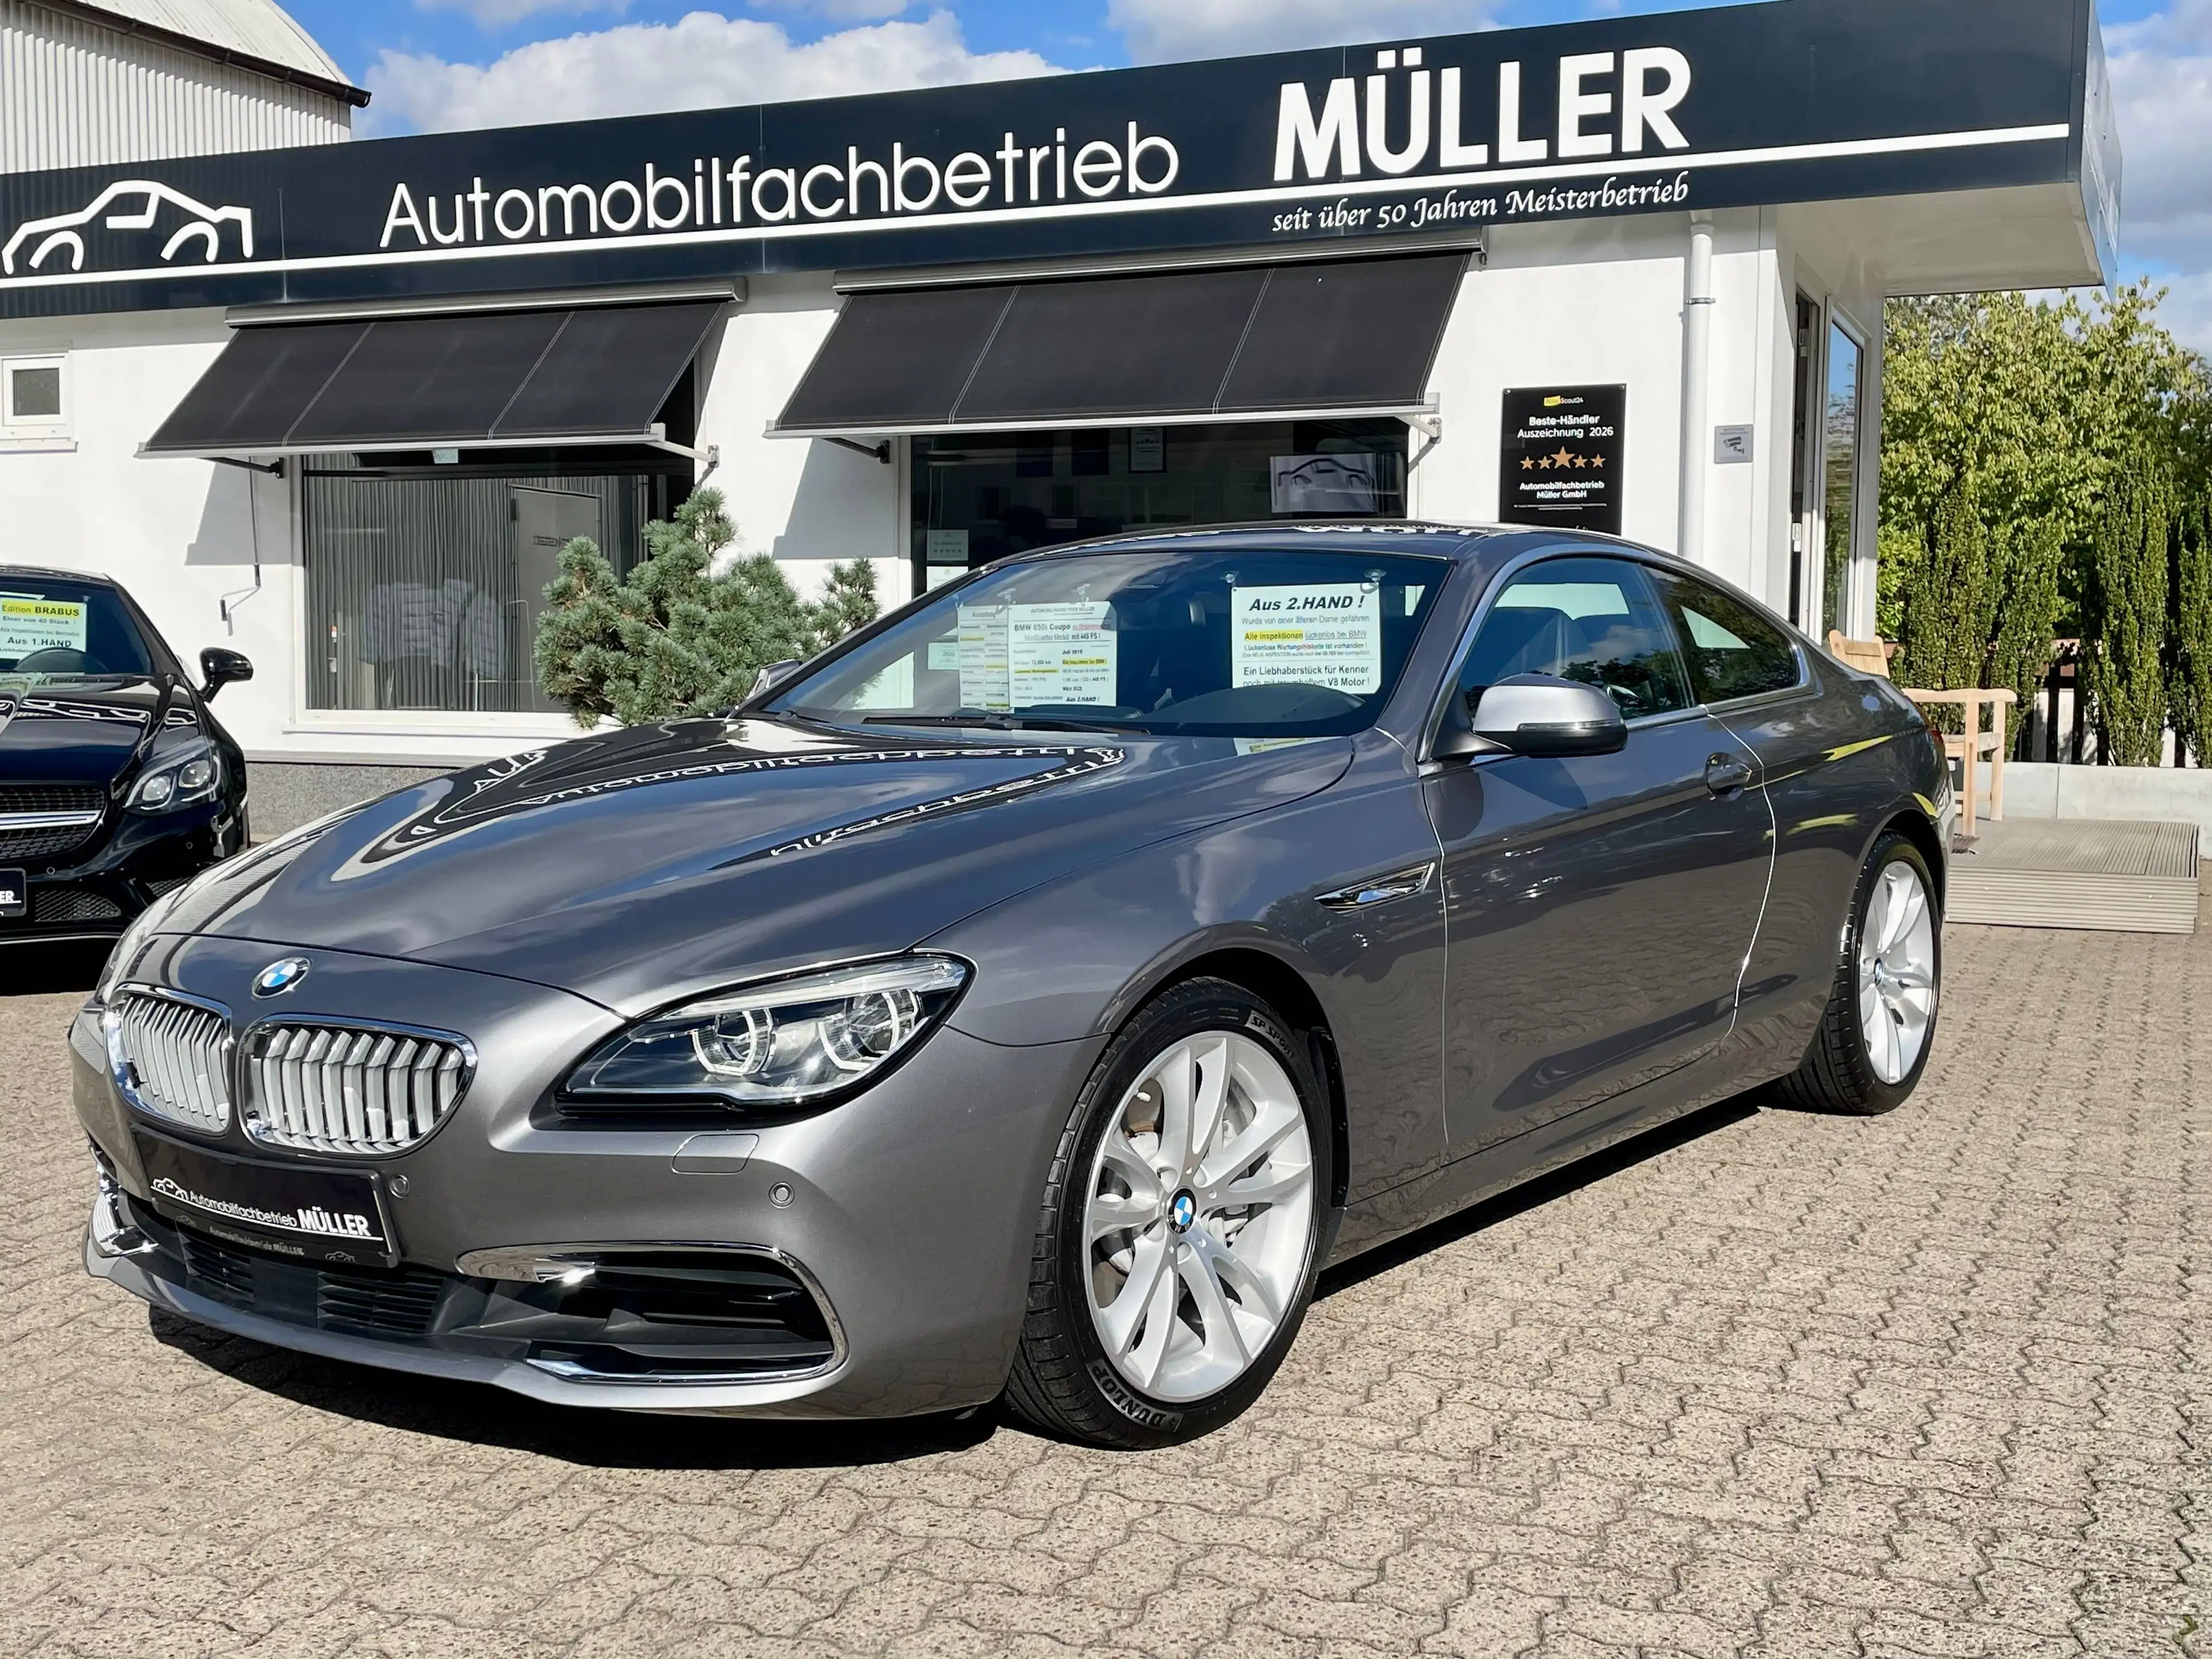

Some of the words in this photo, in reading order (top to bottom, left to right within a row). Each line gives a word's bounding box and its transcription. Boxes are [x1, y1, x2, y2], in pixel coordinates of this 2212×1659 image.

[1273, 46, 1692, 182] MÜLLER
[378, 120, 1179, 248] Automobilfachbetrieb
[1272, 210, 1313, 232] seit
[1318, 198, 1372, 227] über
[1376, 203, 1407, 229] 50
[1410, 189, 1497, 228] Jahren
[1505, 171, 1690, 215] Meisterbetrieb
[1528, 415, 1600, 426] Beste-Händler
[1517, 428, 1584, 439] Auszeichnung
[1589, 426, 1614, 437] 2026
[1519, 480, 1605, 491] Automobilfachbetrieb
[1536, 490, 1560, 499] Müller
[1562, 490, 1587, 498] GmbH
[1249, 598, 1282, 611] Aus
[1286, 596, 1353, 611] 2.HAND
[1358, 595, 1365, 608] !
[2, 605, 32, 613] Edition
[35, 606, 79, 616] BRABUS
[1241, 617, 1262, 625] Wurde
[1319, 615, 1339, 623] Dame
[1340, 615, 1370, 624] gefahren
[1014, 624, 1031, 632] BMW
[1259, 631, 1303, 642] Inspektionen
[1349, 630, 1367, 638] BMW
[7, 637, 27, 645] Aus
[31, 638, 72, 647] 1.HAND
[1244, 667, 1257, 676] Ein
[1259, 666, 1323, 675] Liebhaberstück
[1324, 665, 1336, 674] für
[1338, 665, 1369, 673] Kenner
[1340, 677, 1365, 686] Motor
[190, 1191, 298, 1228] Automobilfachbetrieb
[297, 1206, 372, 1237] MÜLLER
[1093, 1365, 1166, 1426] DUNLOP
